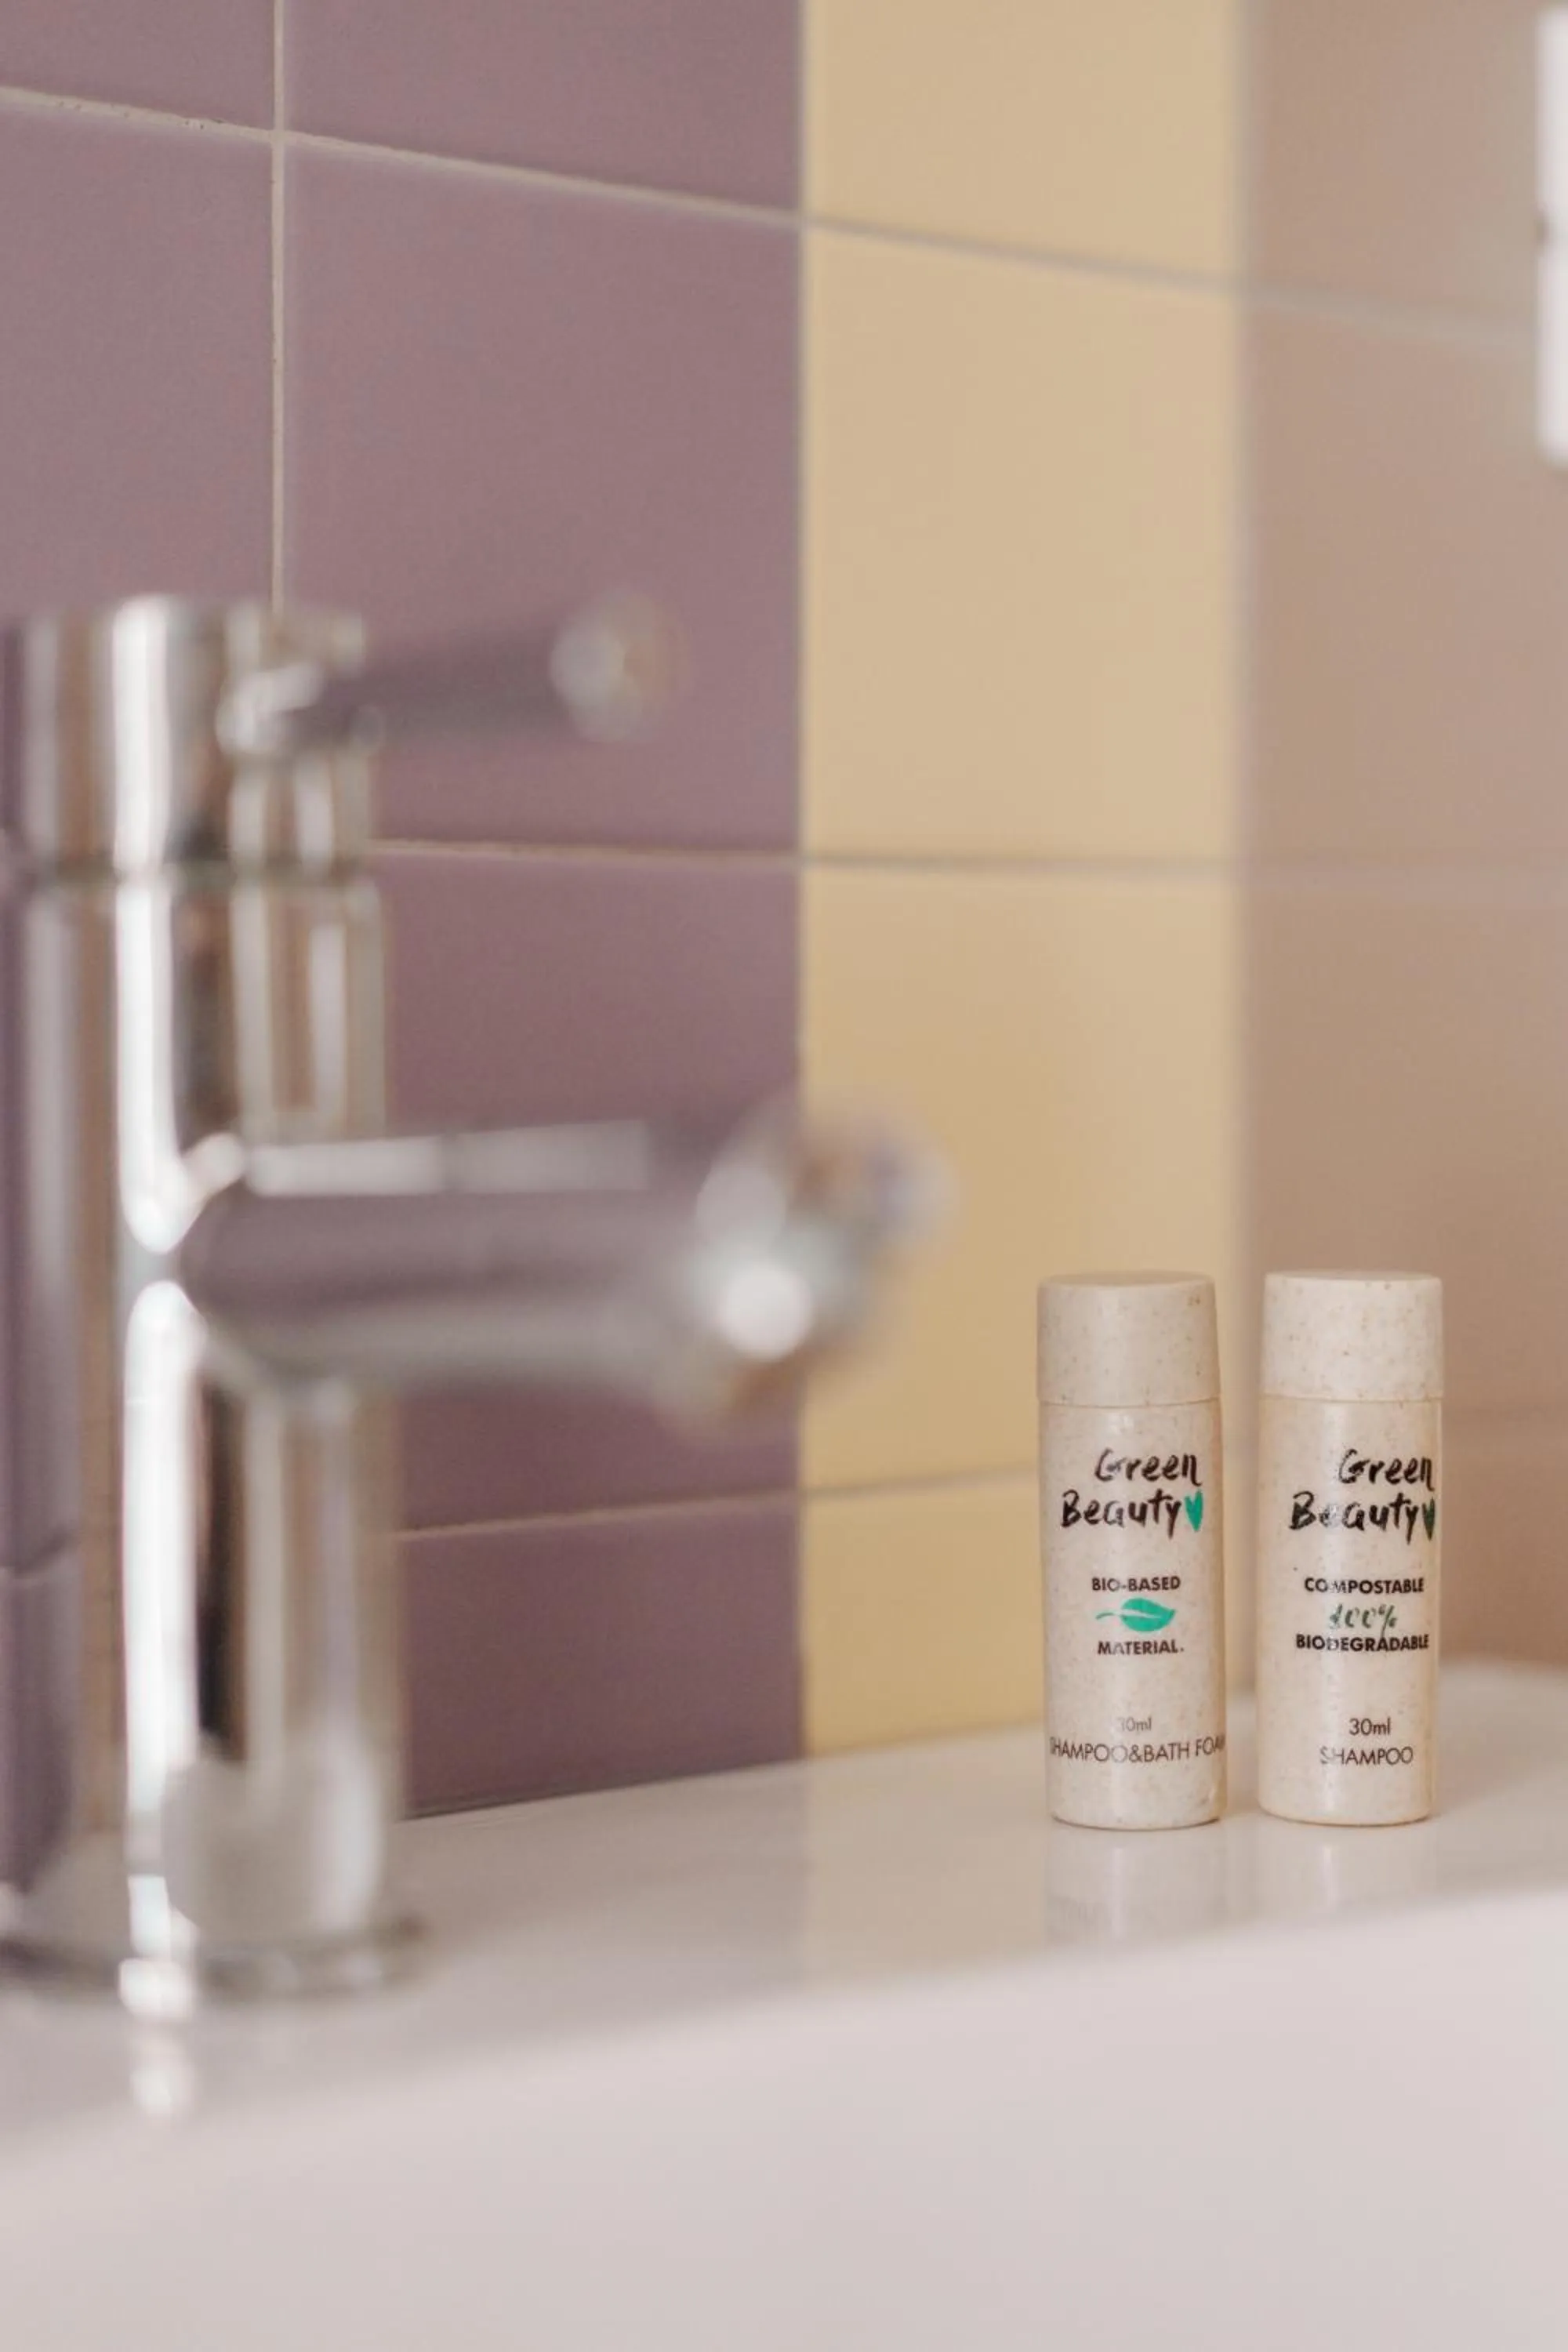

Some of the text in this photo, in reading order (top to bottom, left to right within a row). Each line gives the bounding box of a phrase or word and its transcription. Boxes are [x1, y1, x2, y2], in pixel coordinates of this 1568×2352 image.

[1095, 1448, 1202, 1486] Green
[1339, 1448, 1436, 1491] Green
[1061, 1488, 1182, 1539] Beauty
[1289, 1490, 1419, 1544] Beauty
[1091, 1575, 1181, 1592] BIO-BASED
[1304, 1577, 1425, 1595] COMPOSTABLE
[1296, 1634, 1429, 1652] BIODEGRADABLE
[1348, 1717, 1392, 1736] 30ml
[1319, 1746, 1414, 1766] SHAMPOO
